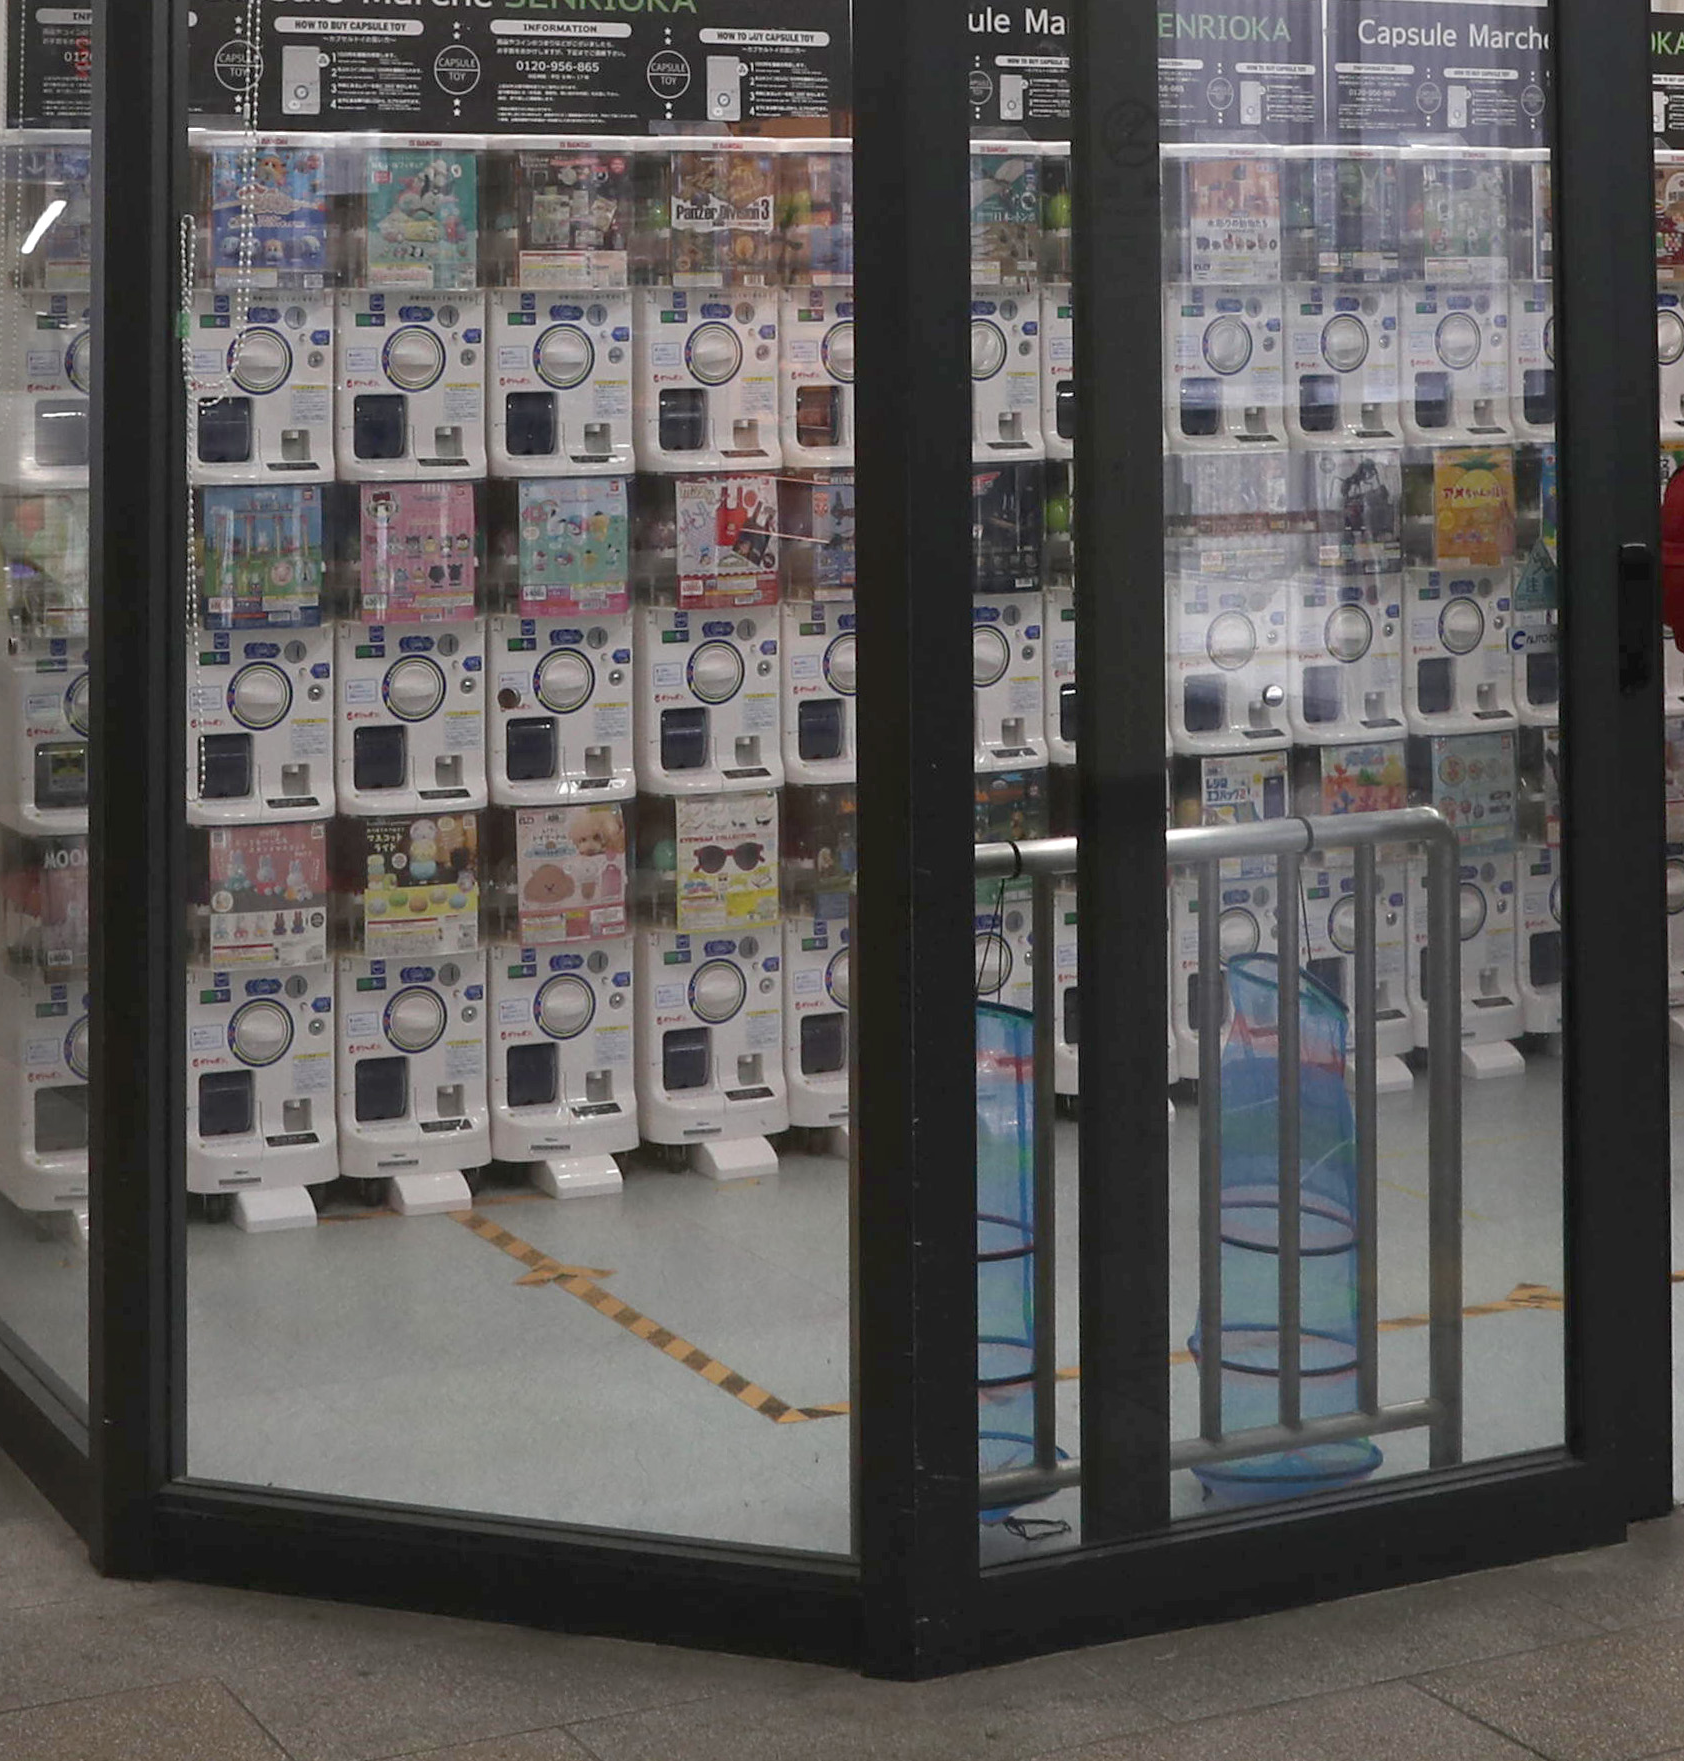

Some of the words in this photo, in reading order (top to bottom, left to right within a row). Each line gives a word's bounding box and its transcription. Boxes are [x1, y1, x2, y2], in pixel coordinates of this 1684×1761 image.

[294, 20, 316, 30] HOW
[317, 21, 329, 30] TO
[331, 22, 348, 31] BUY
[349, 22, 389, 32] CAPSULE
[390, 24, 406, 33] TOY
[523, 23, 598, 33] INFORMATION
[1358, 18, 1457, 48] Capsule
[438, 57, 476, 68] CAPSULE
[515, 59, 601, 73] 0120-956-865
[651, 62, 687, 74] CAPSULE
[448, 72, 466, 82] TOY
[660, 76, 678, 86] TOY
[760, 199, 771, 220] 3
